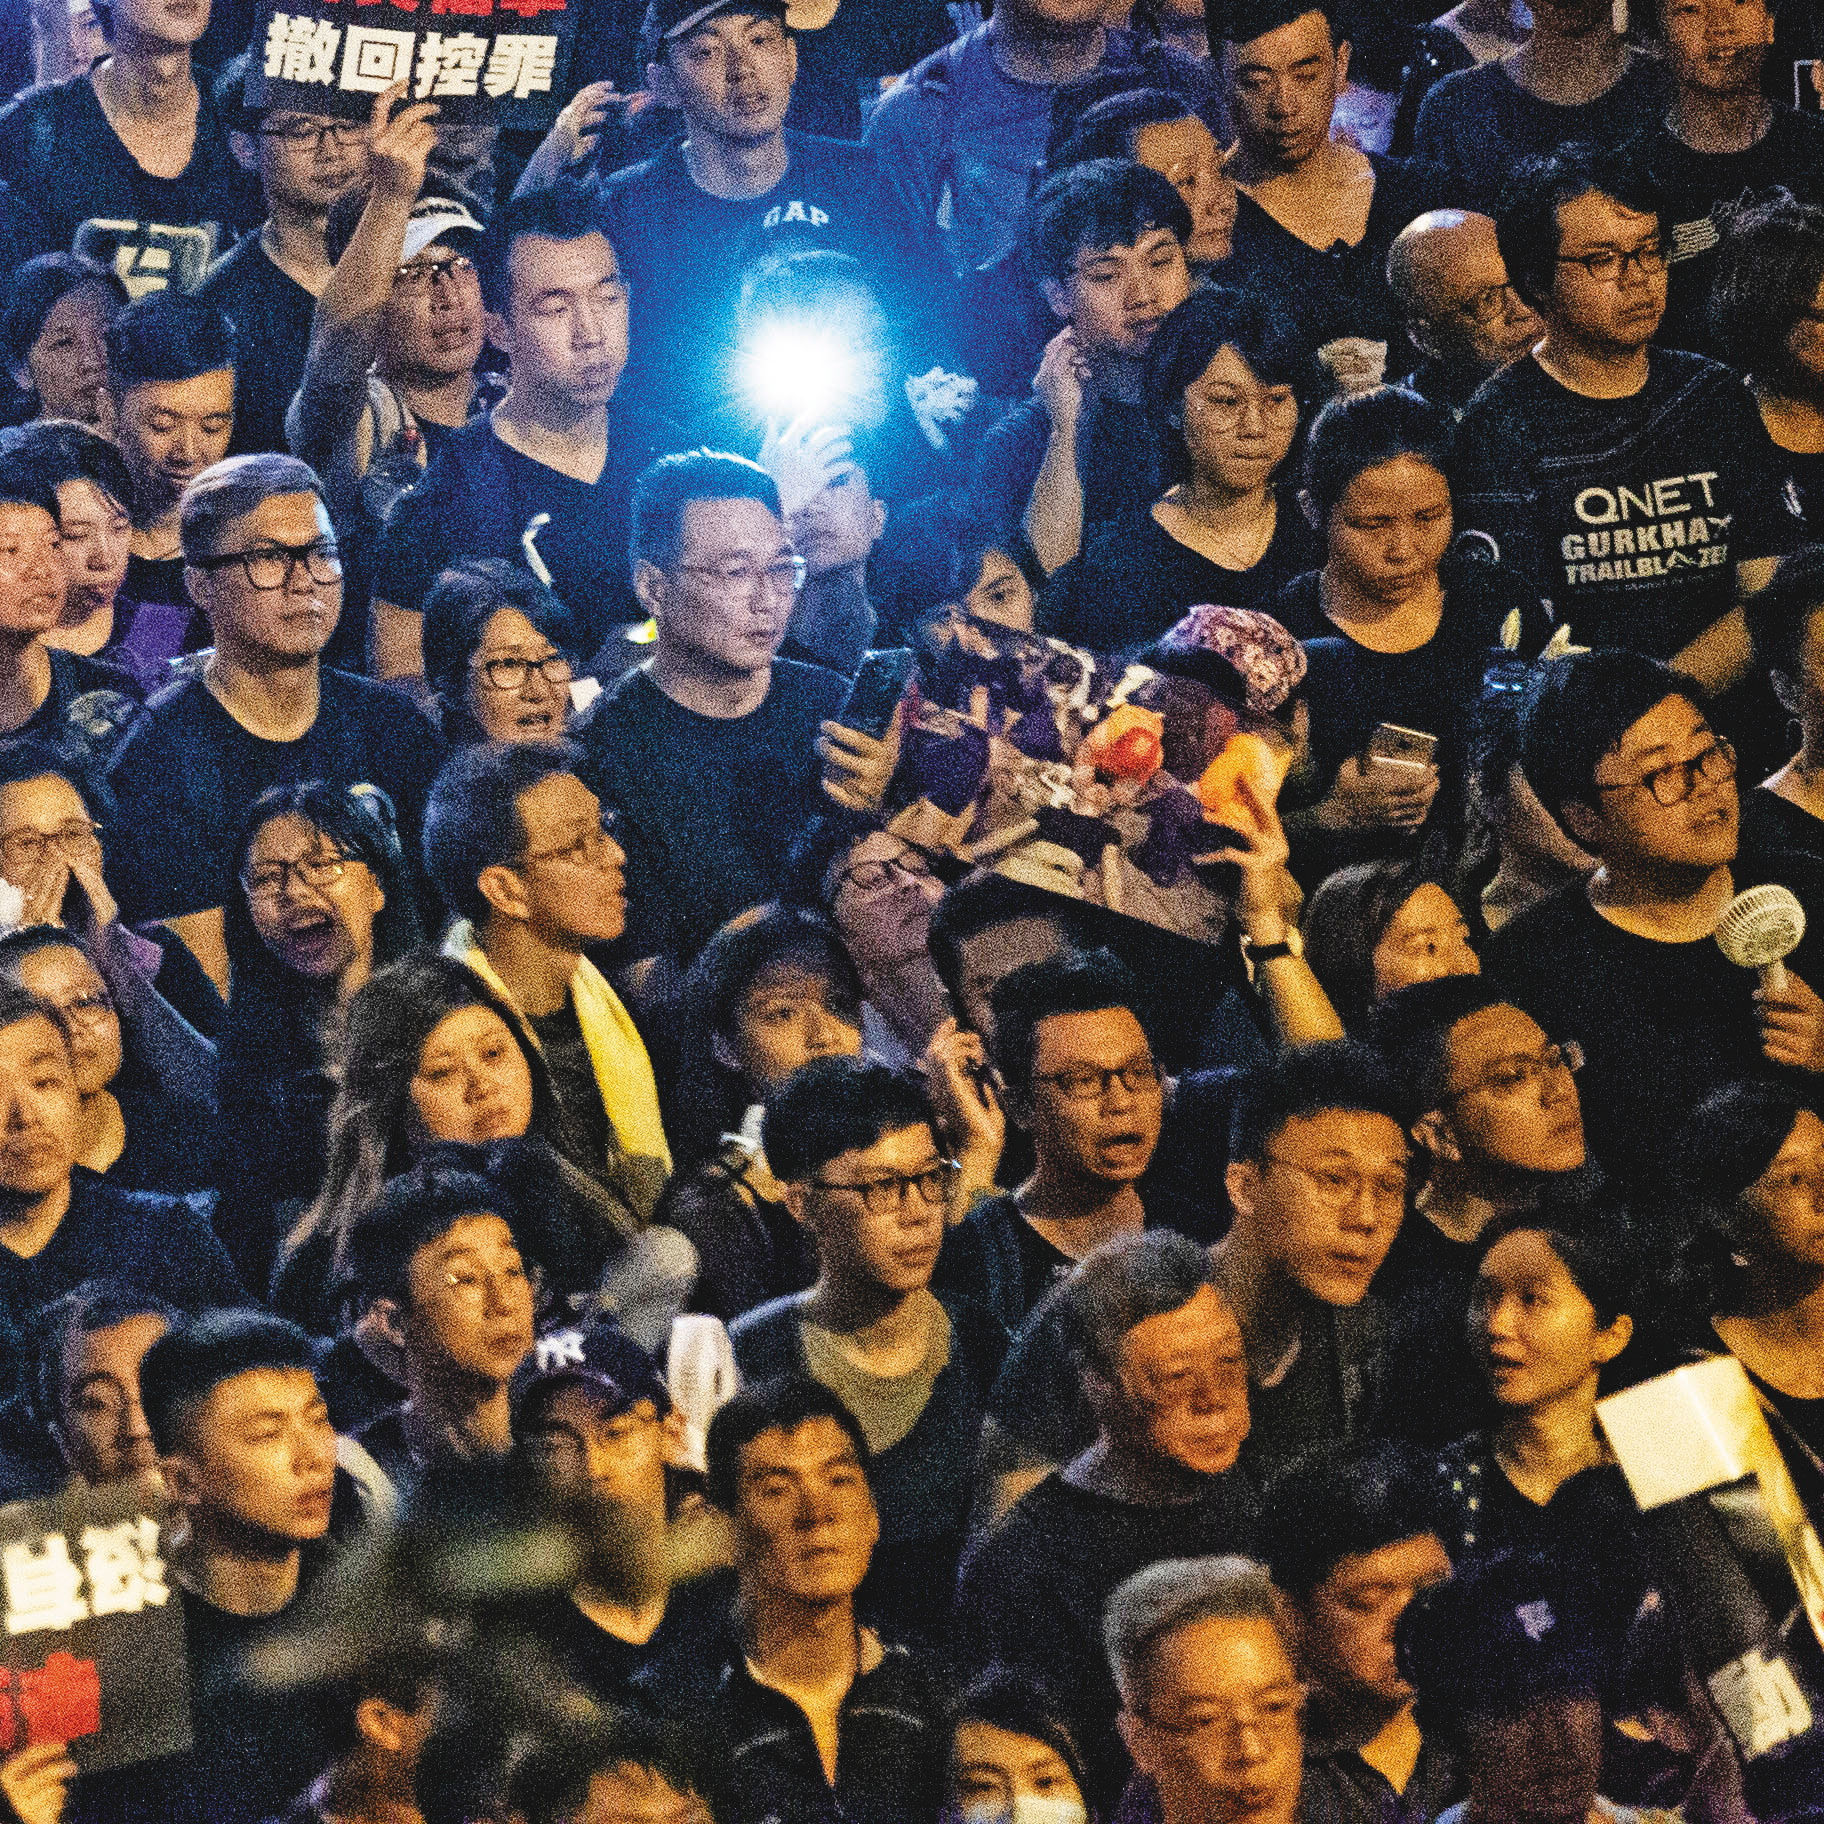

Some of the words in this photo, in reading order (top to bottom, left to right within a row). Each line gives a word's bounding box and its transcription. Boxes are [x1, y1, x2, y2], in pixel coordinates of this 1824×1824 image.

[264, 14, 558, 101] 撤回控罪
[1574, 471, 1720, 521] QNET
